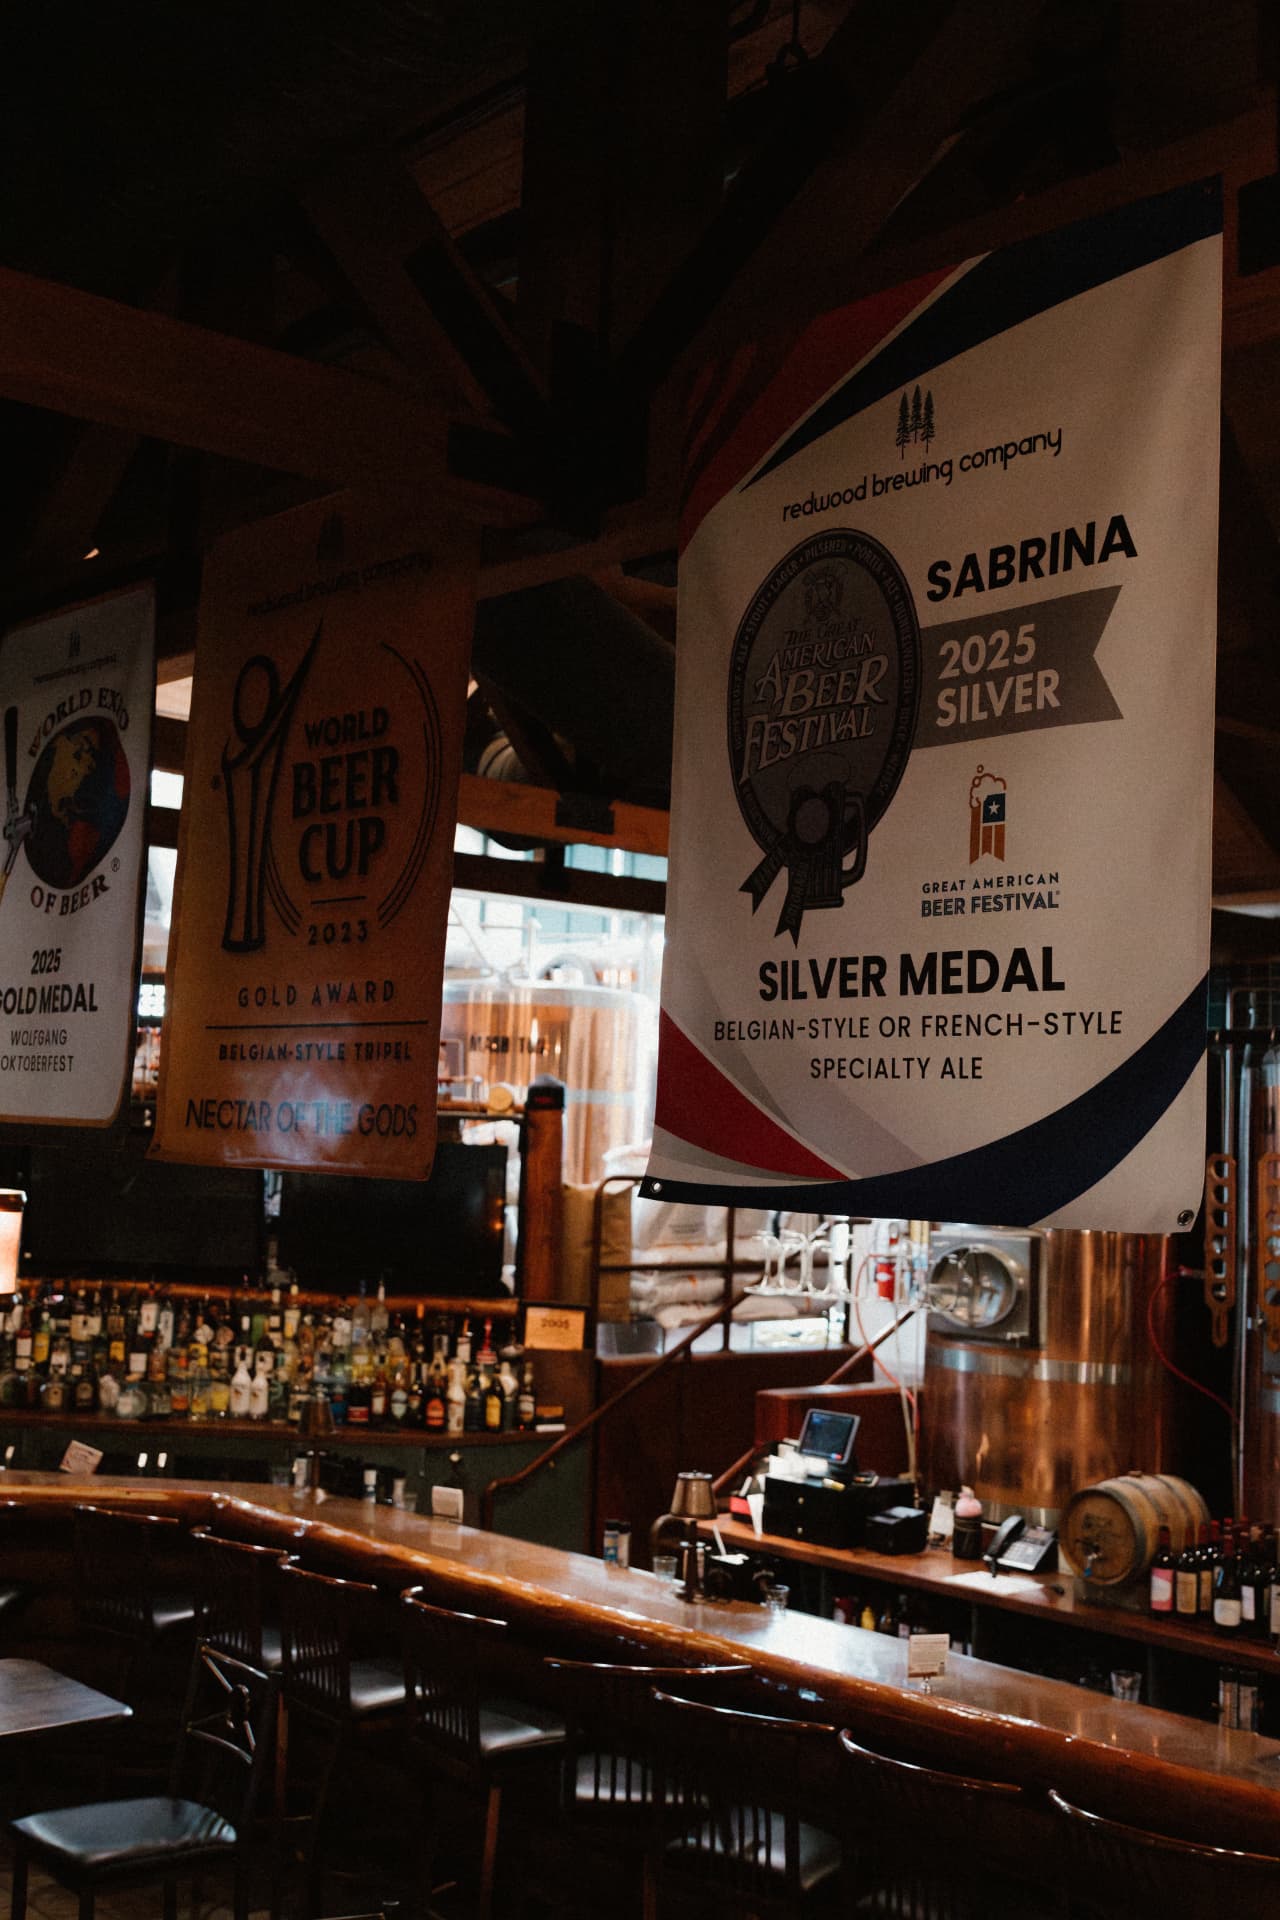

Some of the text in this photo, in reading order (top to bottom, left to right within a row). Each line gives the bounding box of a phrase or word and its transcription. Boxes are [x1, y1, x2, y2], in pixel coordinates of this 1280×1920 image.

[782, 428, 1062, 521] redwood brewing company
[927, 514, 1138, 601] SABRINA
[748, 596, 770, 635] STOUT
[784, 629, 809, 646] THE
[938, 623, 1036, 680] 2025
[752, 631, 876, 704] AMERICAN
[777, 654, 889, 718] BEER
[936, 668, 1061, 728] SILVER
[28, 688, 92, 757] WORLD
[304, 707, 389, 748] WORLD
[739, 704, 874, 787] FESTIVAL
[292, 746, 399, 819] BEER
[300, 817, 386, 882] CUP
[30, 874, 109, 916] OF BEER
[922, 872, 1059, 894] GREAT AMERICAN
[921, 898, 966, 918] BEER
[308, 919, 369, 946] 2023
[31, 948, 62, 975] 2025
[759, 946, 1065, 1001] SILVER MEDAL
[0, 983, 98, 1015] OLD MEDAL
[238, 980, 395, 1008] GOLD AWARD
[10, 1029, 68, 1046] WOLFGANG
[714, 1011, 1123, 1042] BELGIAN-STYLE OR FRENCH-STYLE
[0, 1055, 74, 1072] OKTOBERFEST
[219, 1041, 412, 1061] BELGIAN-STYLE TRIPEL
[810, 1057, 983, 1080] SPECIALTY ALE
[185, 1099, 418, 1139] NECTAR OF THE GODS
